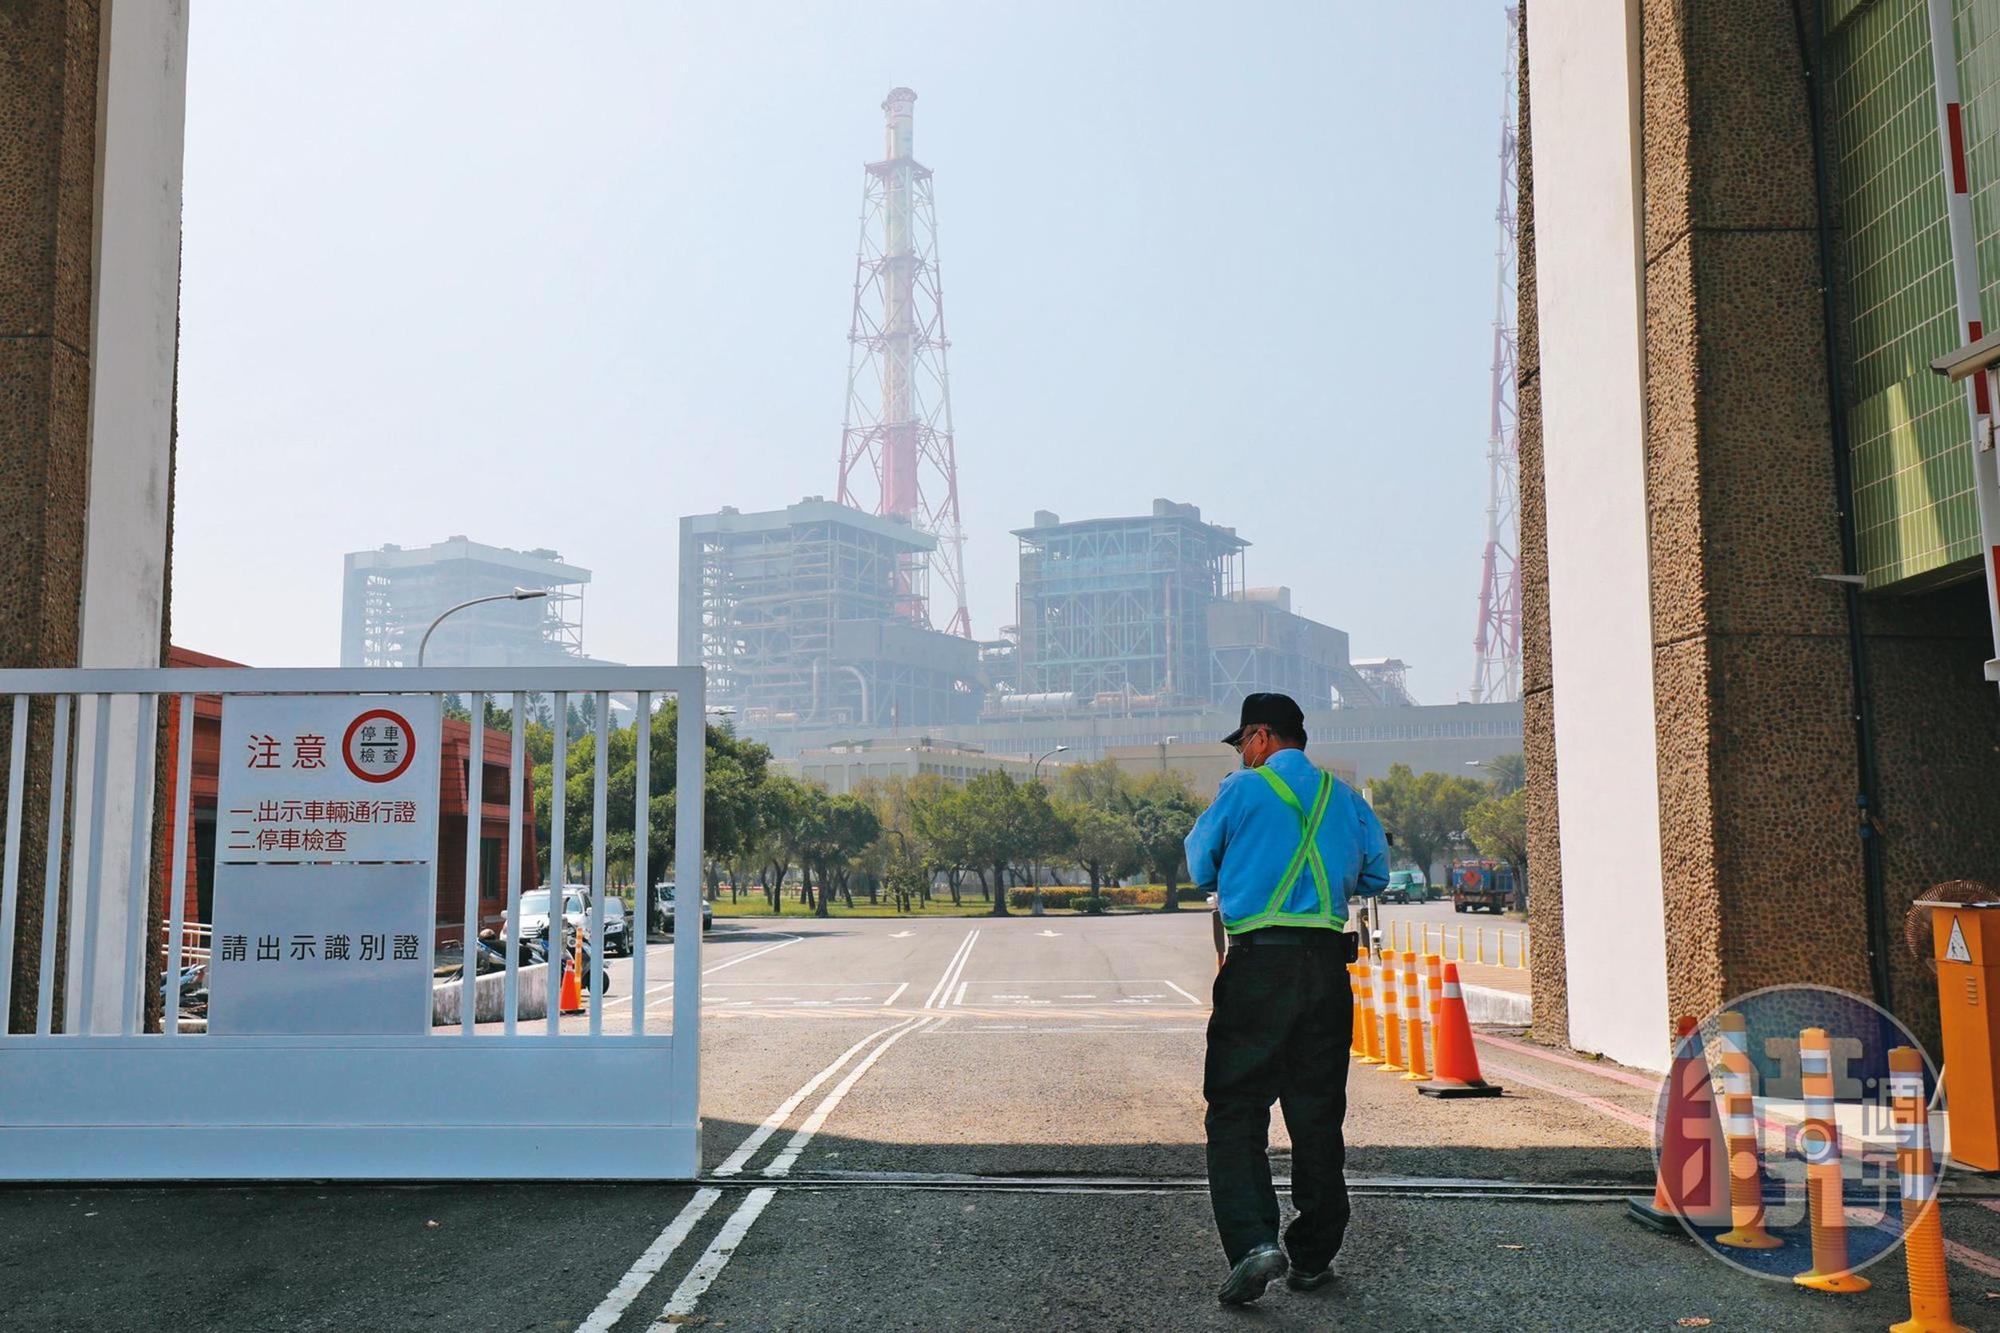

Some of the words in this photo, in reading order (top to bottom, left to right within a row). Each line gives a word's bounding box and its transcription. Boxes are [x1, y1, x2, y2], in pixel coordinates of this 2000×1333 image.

[360, 726, 399, 741] 停車
[248, 734, 326, 768] 注意
[360, 748, 398, 763] 檢查
[230, 800, 416, 823] 一.出示車輛通行證
[229, 828, 346, 852] 二.停車檢查
[221, 934, 419, 962] 請出示識別證
